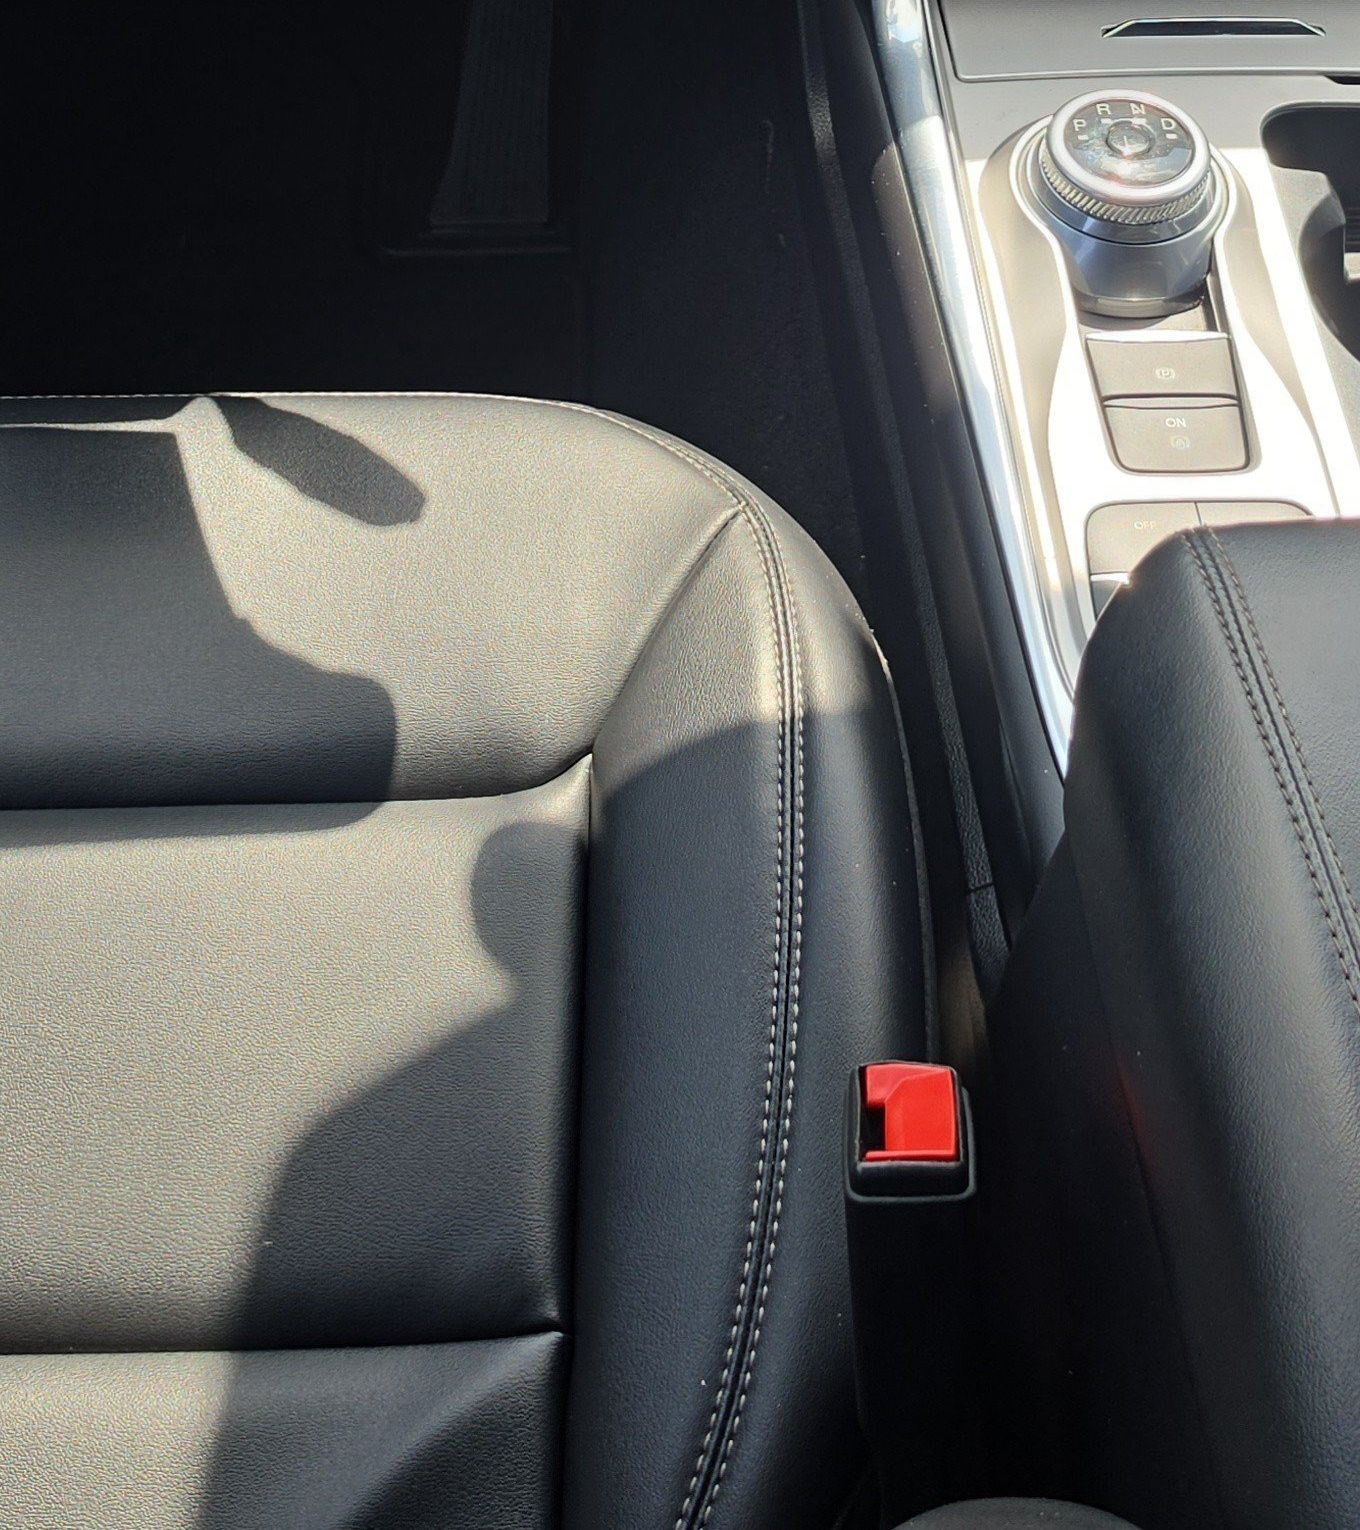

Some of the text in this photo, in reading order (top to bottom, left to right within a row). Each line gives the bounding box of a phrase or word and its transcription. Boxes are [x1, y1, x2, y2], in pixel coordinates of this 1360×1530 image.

[1073, 103, 1176, 132] P R N D
[1165, 417, 1187, 428] ON
